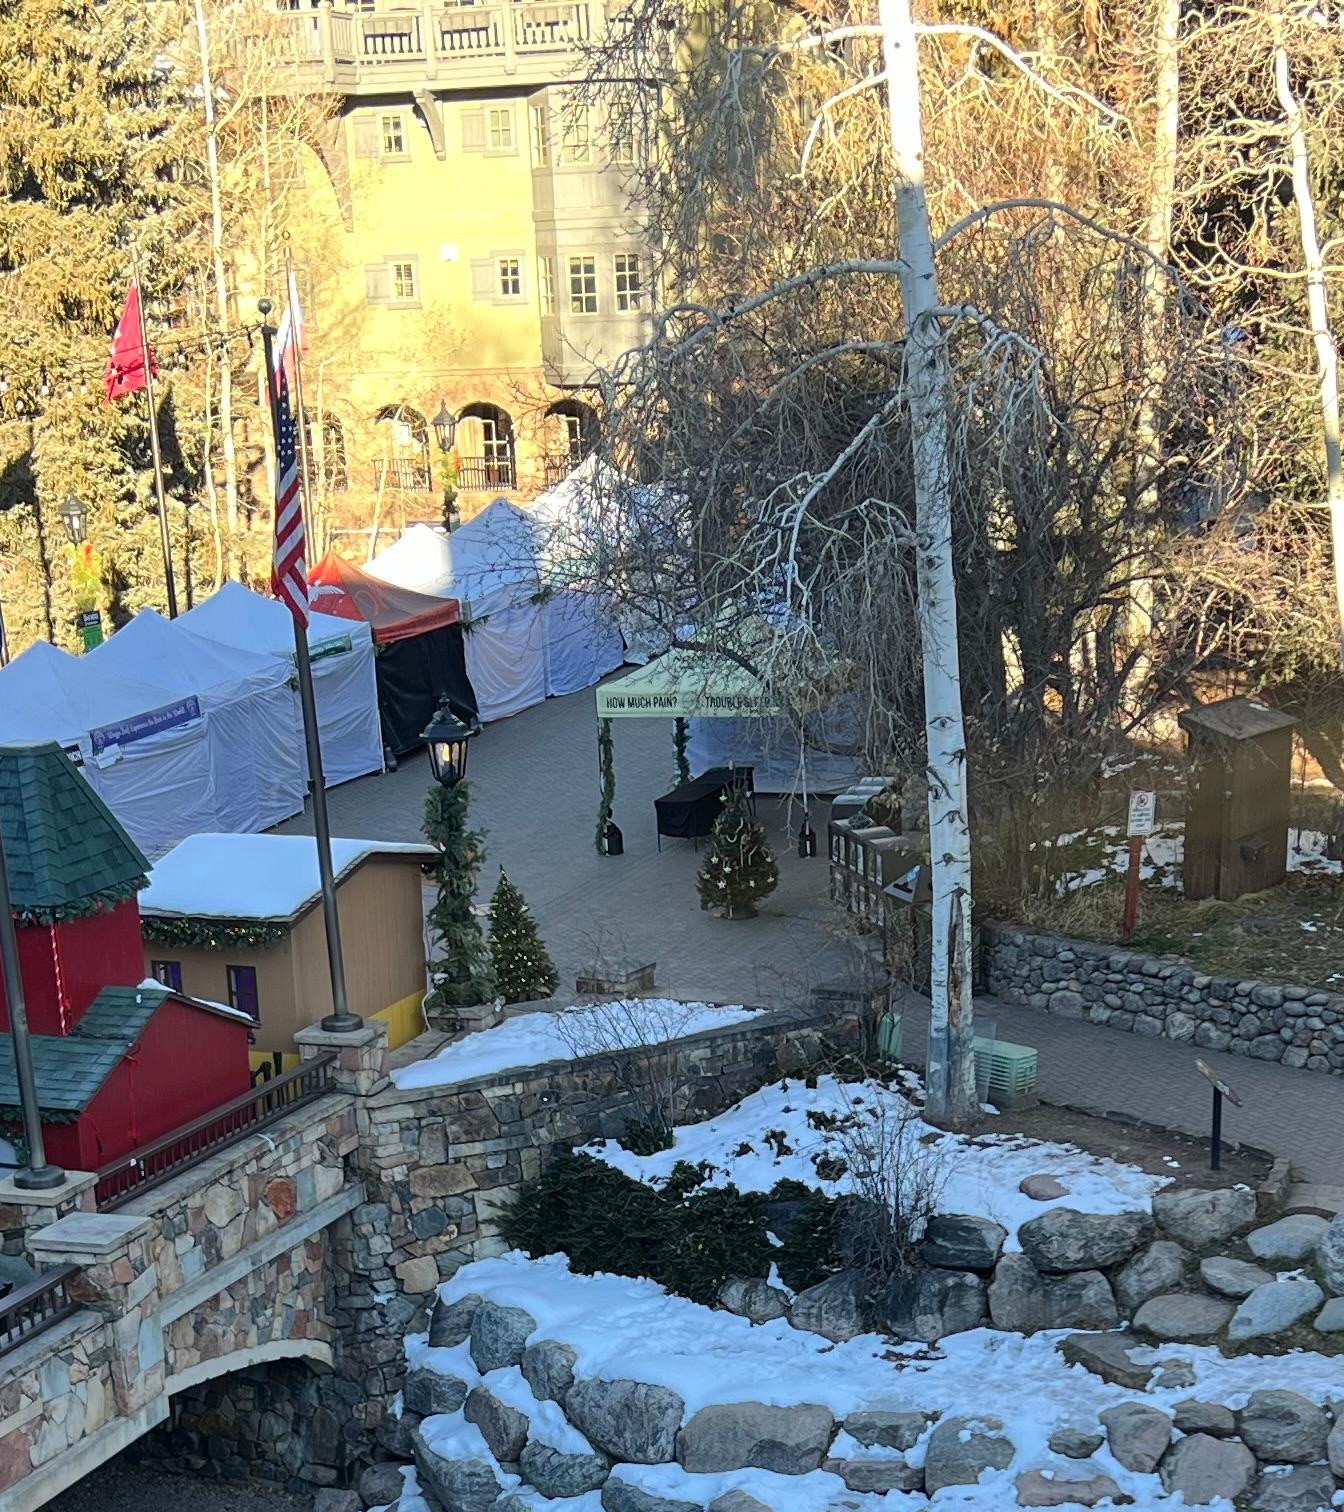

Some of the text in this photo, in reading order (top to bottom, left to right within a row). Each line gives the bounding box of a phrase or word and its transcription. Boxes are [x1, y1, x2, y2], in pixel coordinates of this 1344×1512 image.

[606, 696, 678, 709] HOW MUCH PAIN?
